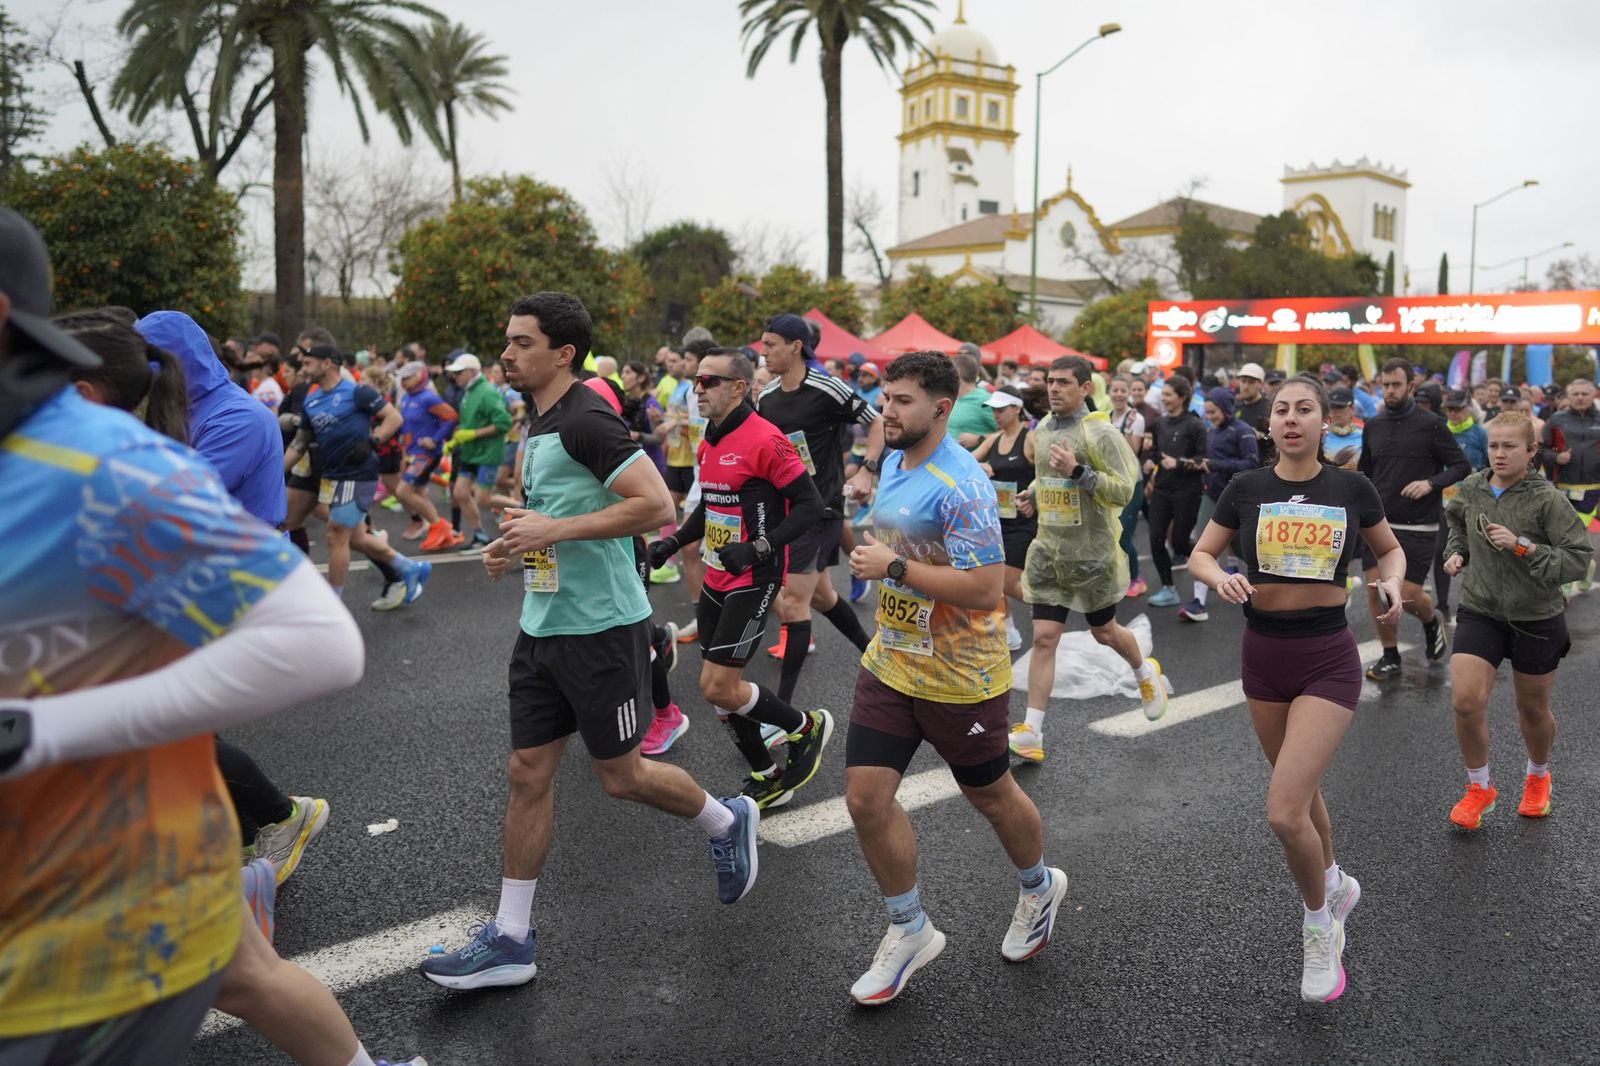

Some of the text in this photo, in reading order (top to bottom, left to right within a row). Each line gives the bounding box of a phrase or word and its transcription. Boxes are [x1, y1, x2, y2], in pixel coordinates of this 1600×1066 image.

[1040, 489, 1071, 506] 18078
[1264, 520, 1332, 546] 18732
[756, 583, 776, 618] WONG
[879, 589, 920, 625] 4952
